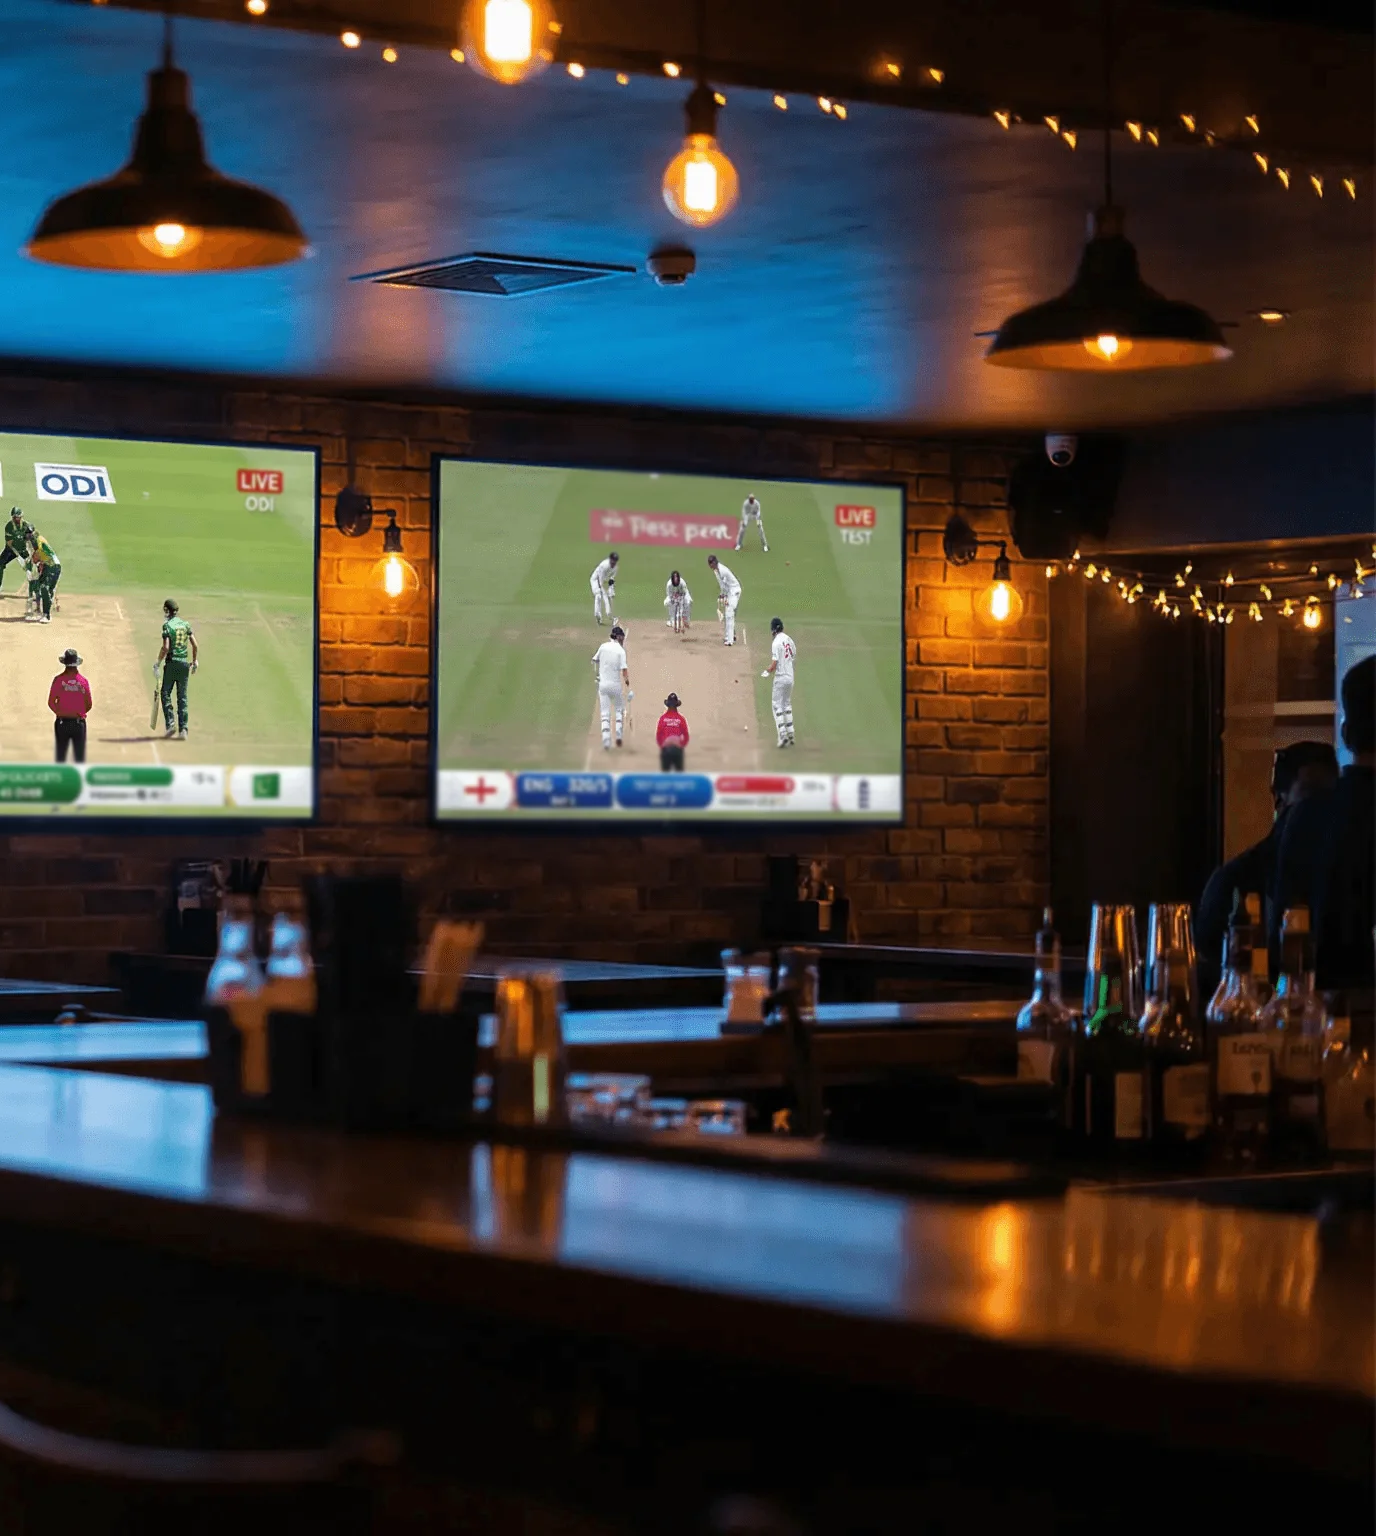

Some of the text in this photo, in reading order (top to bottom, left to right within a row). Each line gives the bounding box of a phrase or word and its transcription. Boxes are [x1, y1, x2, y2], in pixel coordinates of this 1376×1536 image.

[40, 473, 108, 498] ODI
[240, 473, 280, 491] LIVE
[244, 496, 275, 512] ODI
[838, 508, 872, 526] LIVE
[840, 528, 873, 545] TEST
